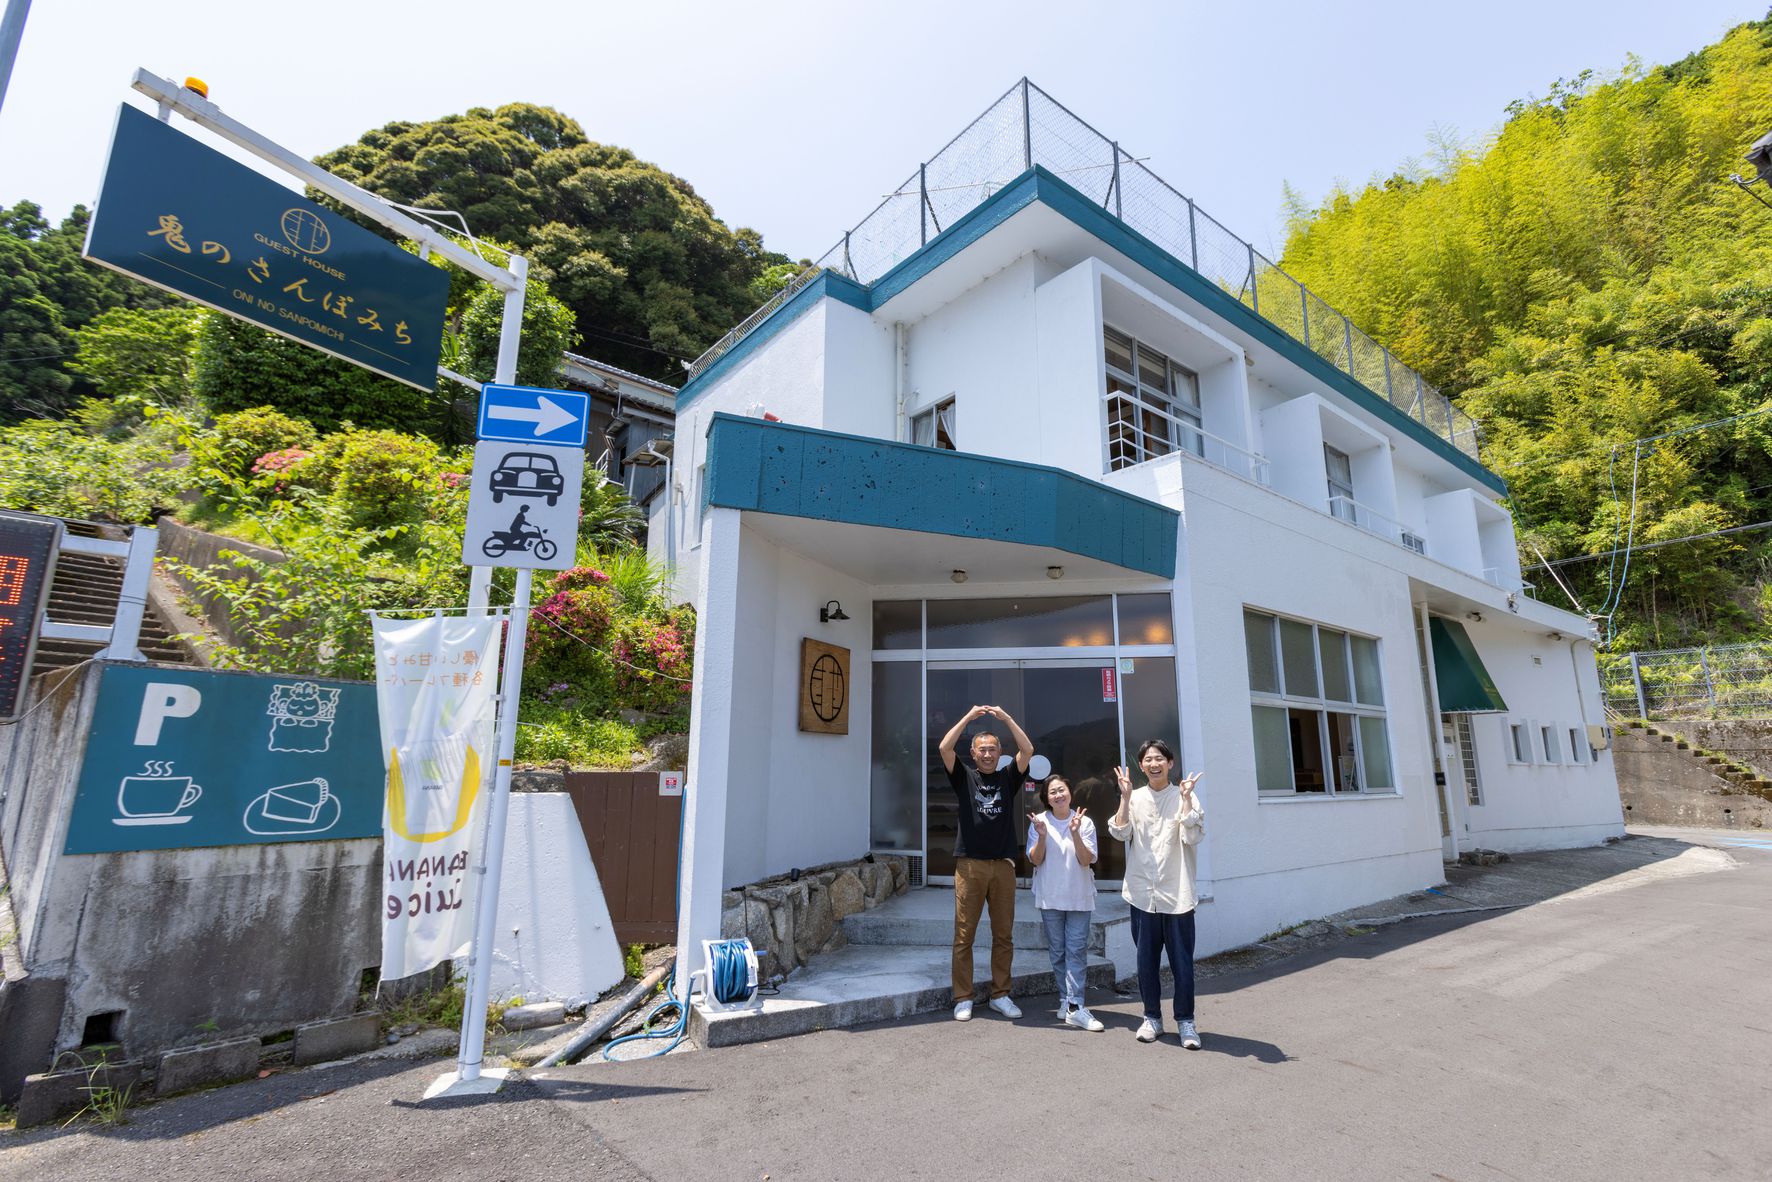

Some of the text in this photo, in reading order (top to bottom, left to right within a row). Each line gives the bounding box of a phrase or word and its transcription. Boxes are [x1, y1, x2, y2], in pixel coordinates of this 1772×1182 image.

[146, 213, 413, 346] 鬼のさんぽみち
[253, 232, 347, 282] GUEST HOUSE
[232, 288, 345, 342] ONI NO SANPOMICHI
[133, 682, 202, 746] P
